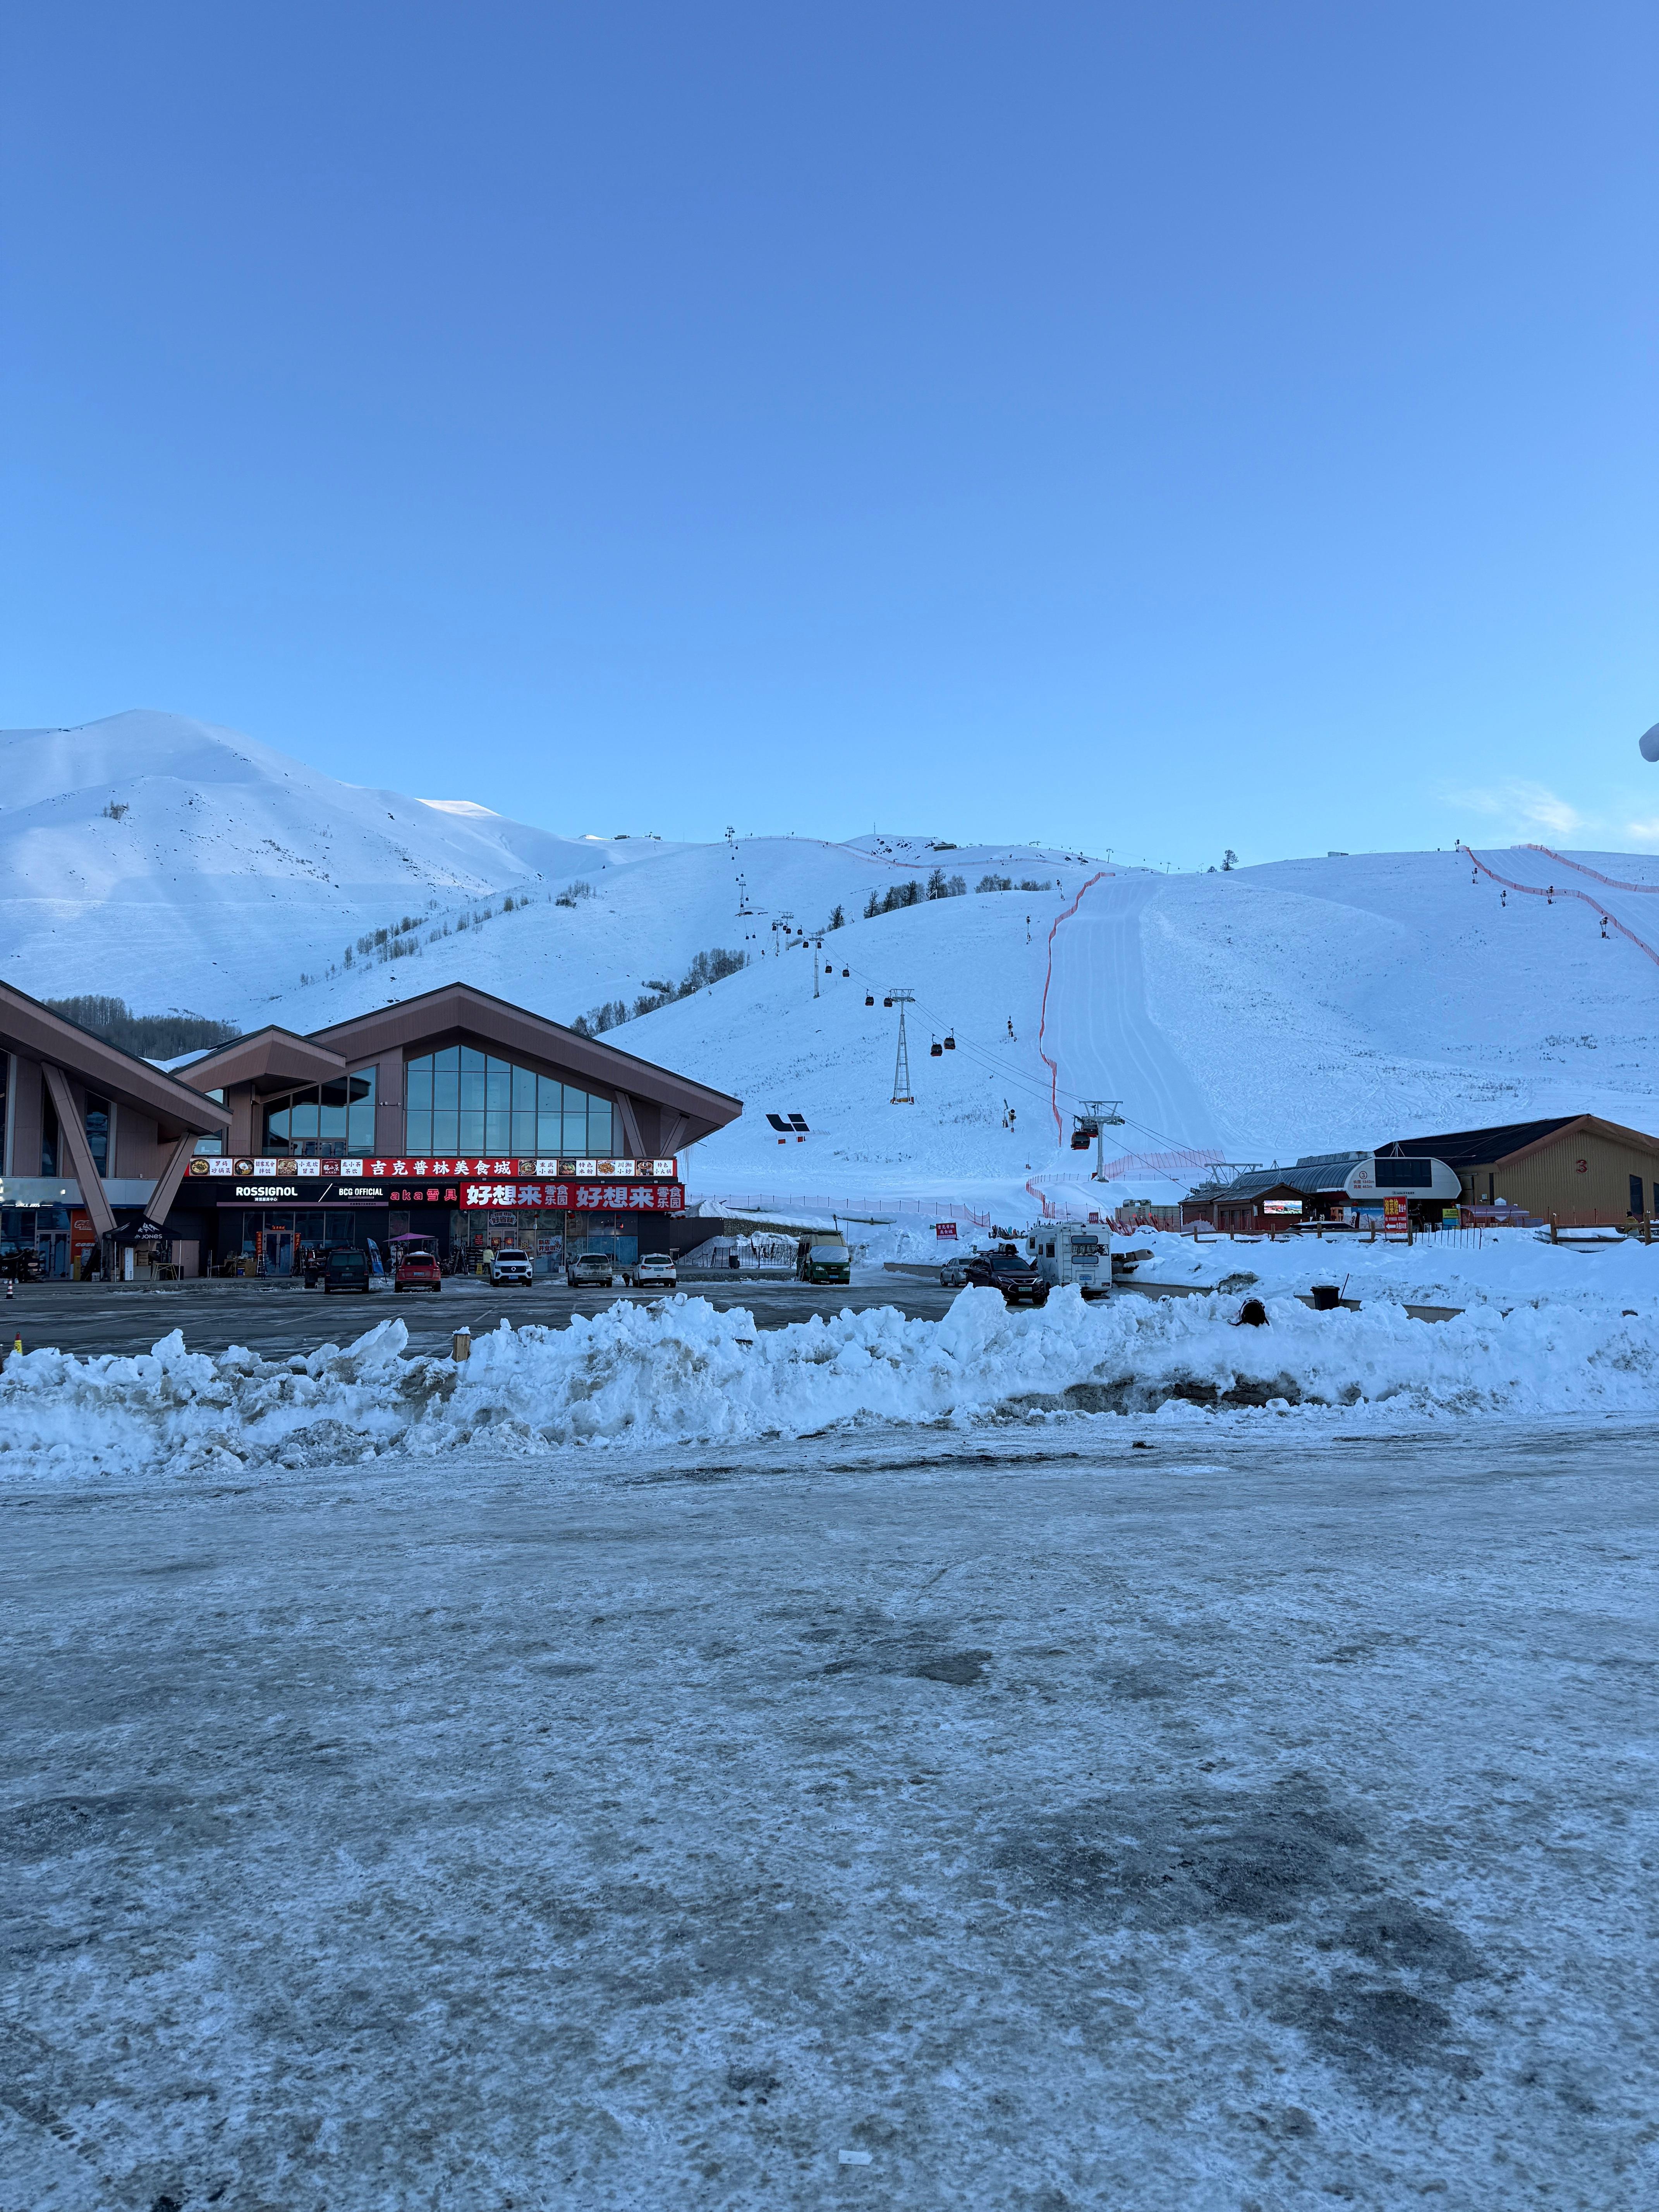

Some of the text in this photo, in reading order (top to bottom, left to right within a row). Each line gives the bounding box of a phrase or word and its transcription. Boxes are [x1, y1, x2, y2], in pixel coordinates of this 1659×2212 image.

[370, 1160, 511, 1176] 吉克普林美食城
[1576, 1160, 1587, 1173] 3
[236, 1187, 298, 1196] ROSSIGNOL
[466, 1185, 542, 1206] 好想来
[545, 1185, 568, 1195] 零食
[657, 1187, 682, 1197] 零食
[545, 1195, 568, 1206] 乐园
[576, 1187, 654, 1208] 好想来
[657, 1197, 681, 1208] 乐园
